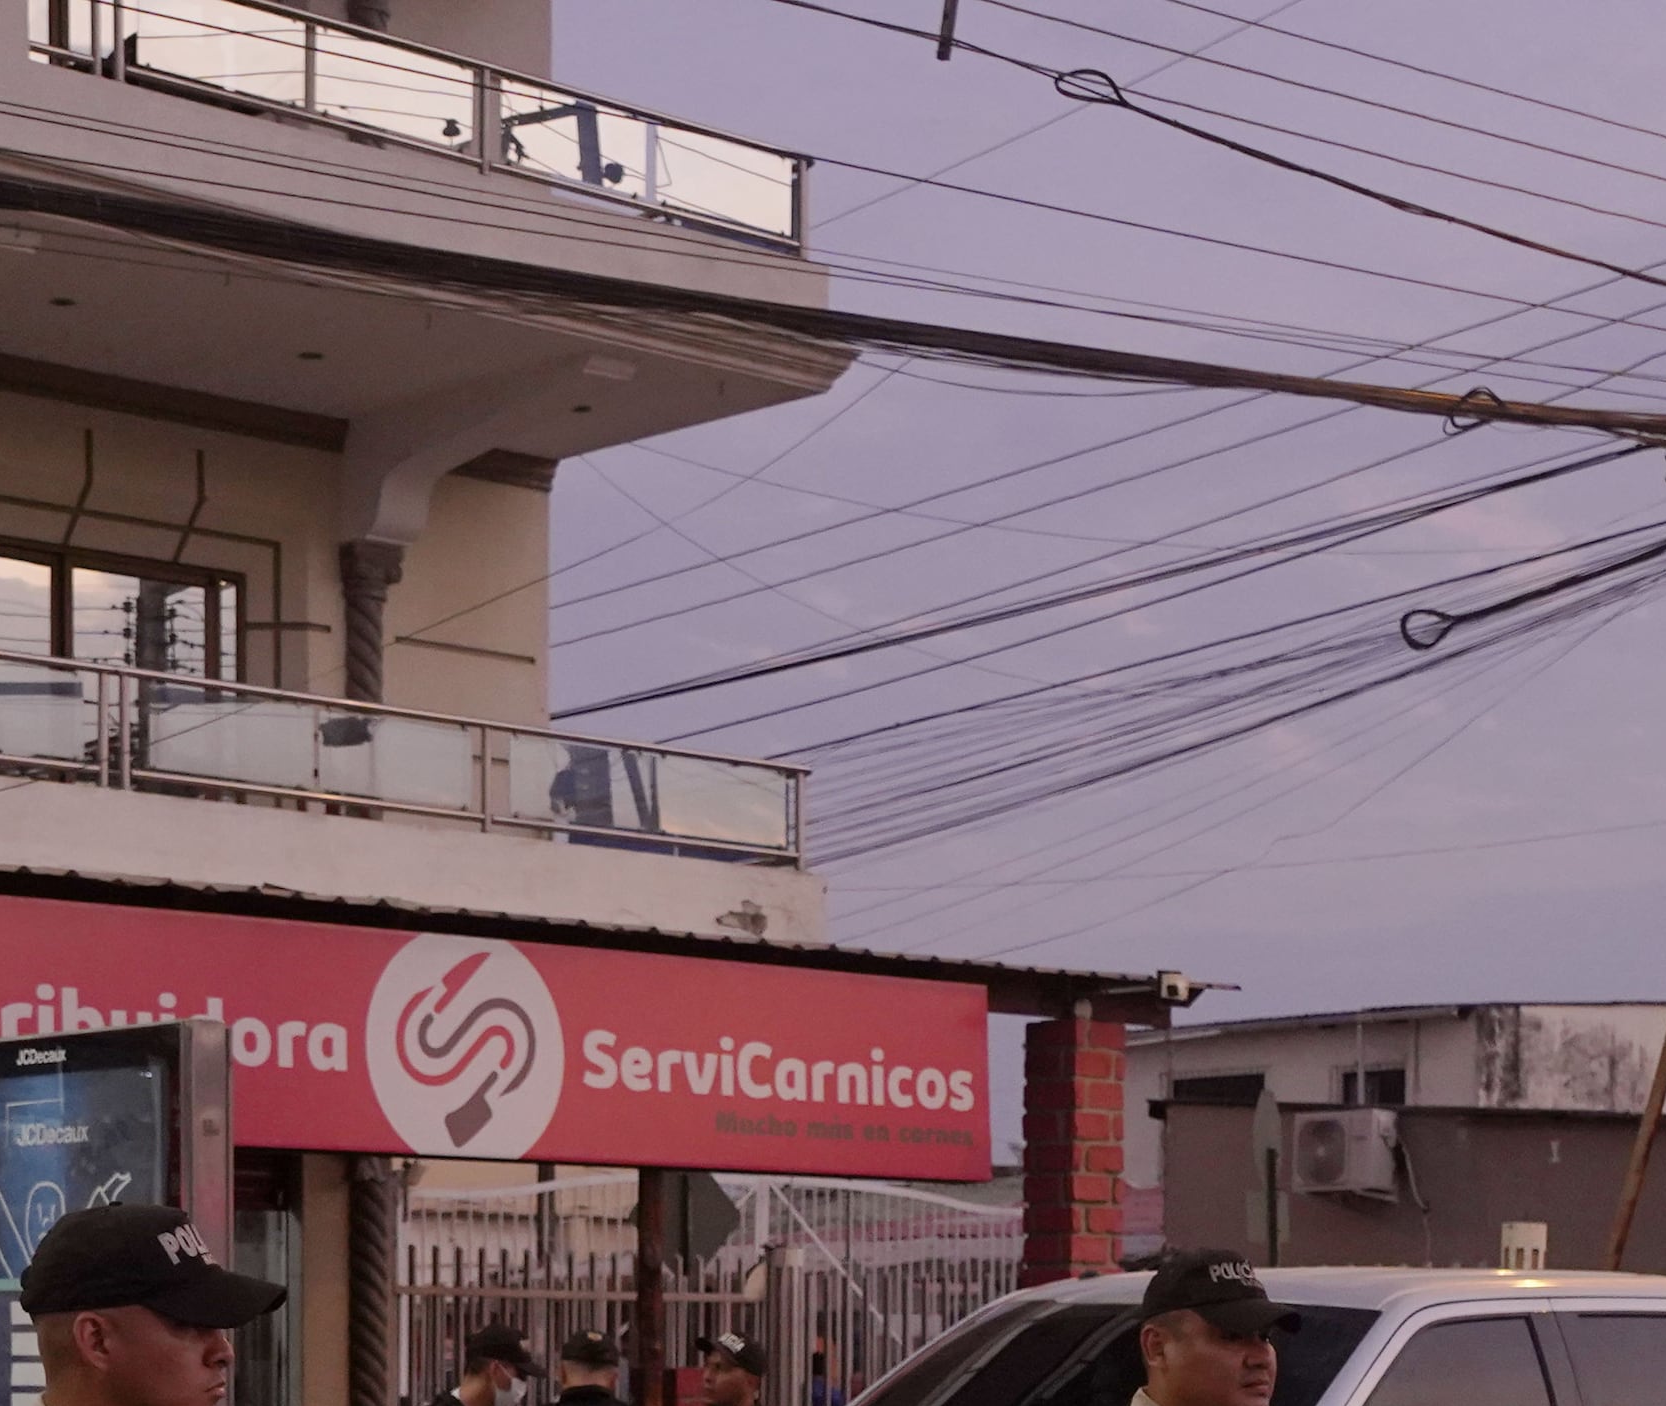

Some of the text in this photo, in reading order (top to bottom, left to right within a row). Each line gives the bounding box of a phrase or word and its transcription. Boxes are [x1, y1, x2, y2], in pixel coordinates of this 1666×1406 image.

[16, 1048, 66, 1066] JCDecaux
[581, 1029, 970, 1113] ServiCarnicos
[16, 1123, 89, 1147] JCDecaux
